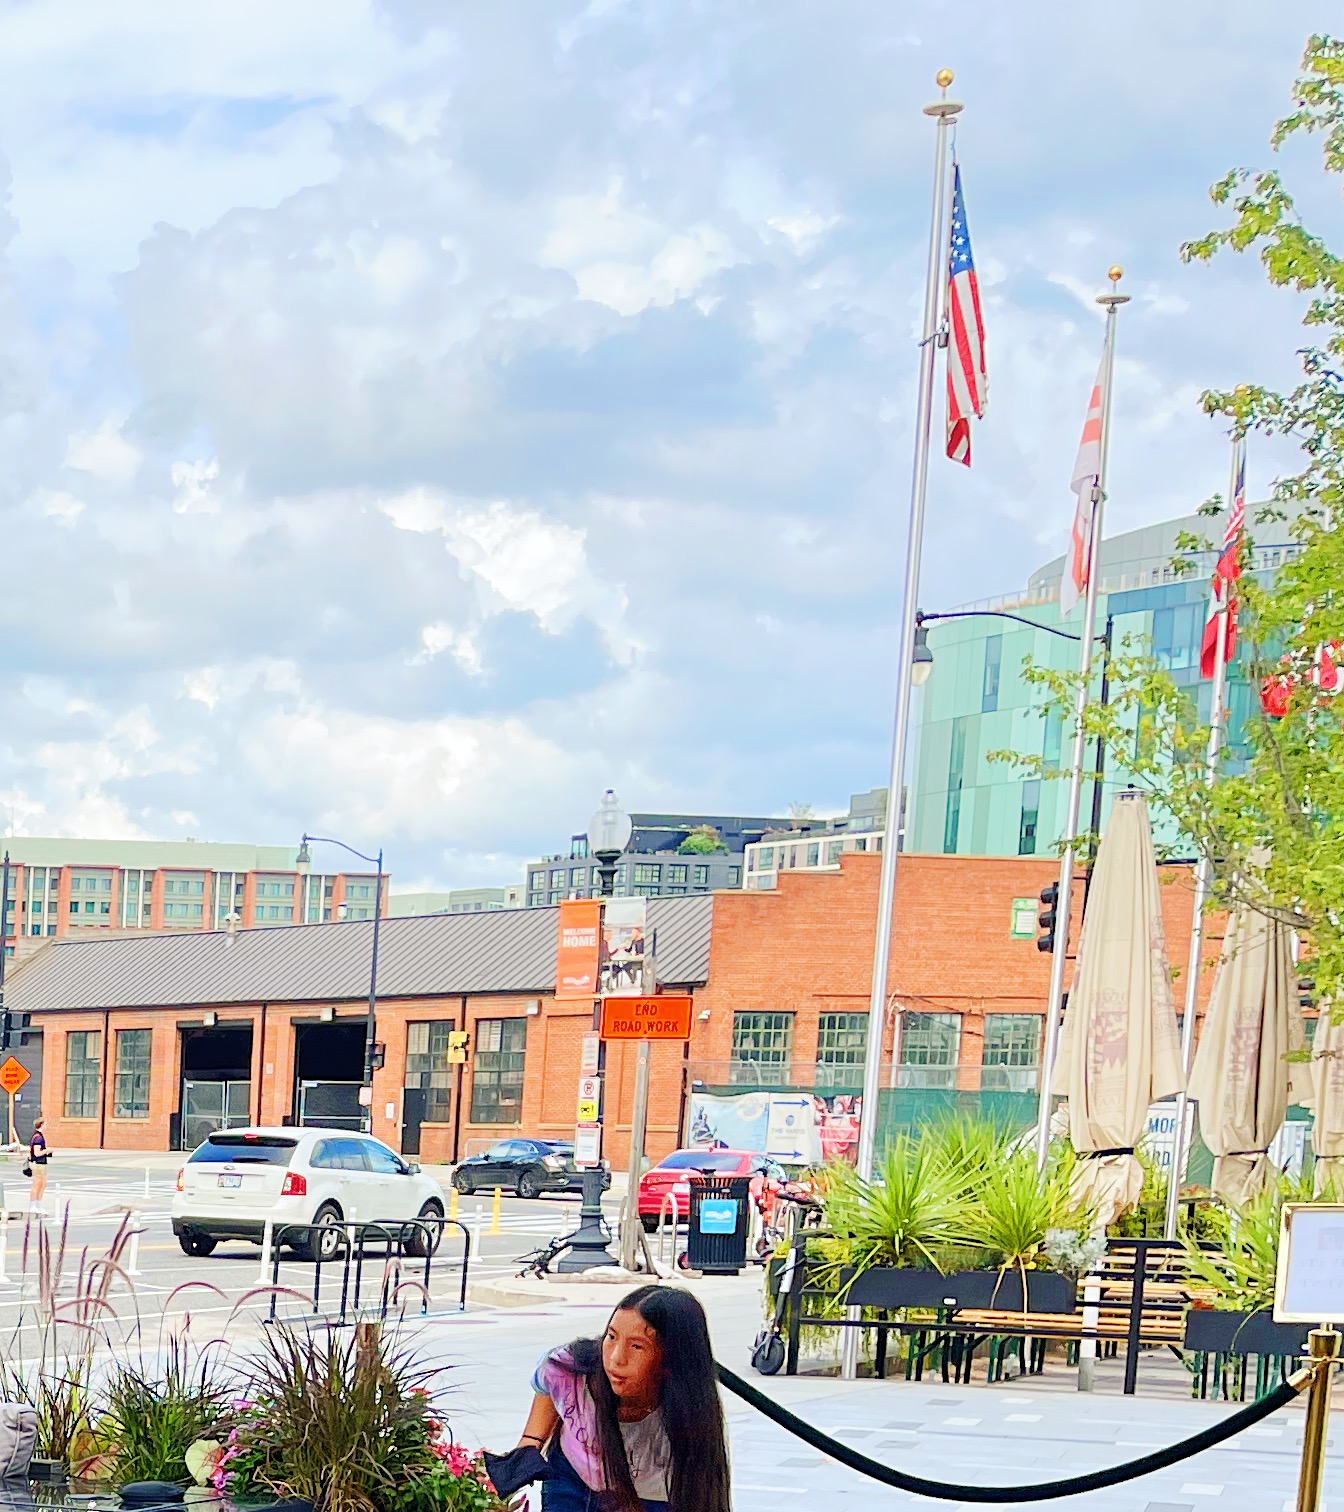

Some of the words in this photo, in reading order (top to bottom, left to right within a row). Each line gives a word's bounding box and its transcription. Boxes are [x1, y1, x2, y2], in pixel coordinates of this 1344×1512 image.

[562, 935, 596, 947] HOME
[635, 1003, 657, 1016] END
[613, 1020, 642, 1033] ROAD
[647, 1020, 679, 1033] WORK
